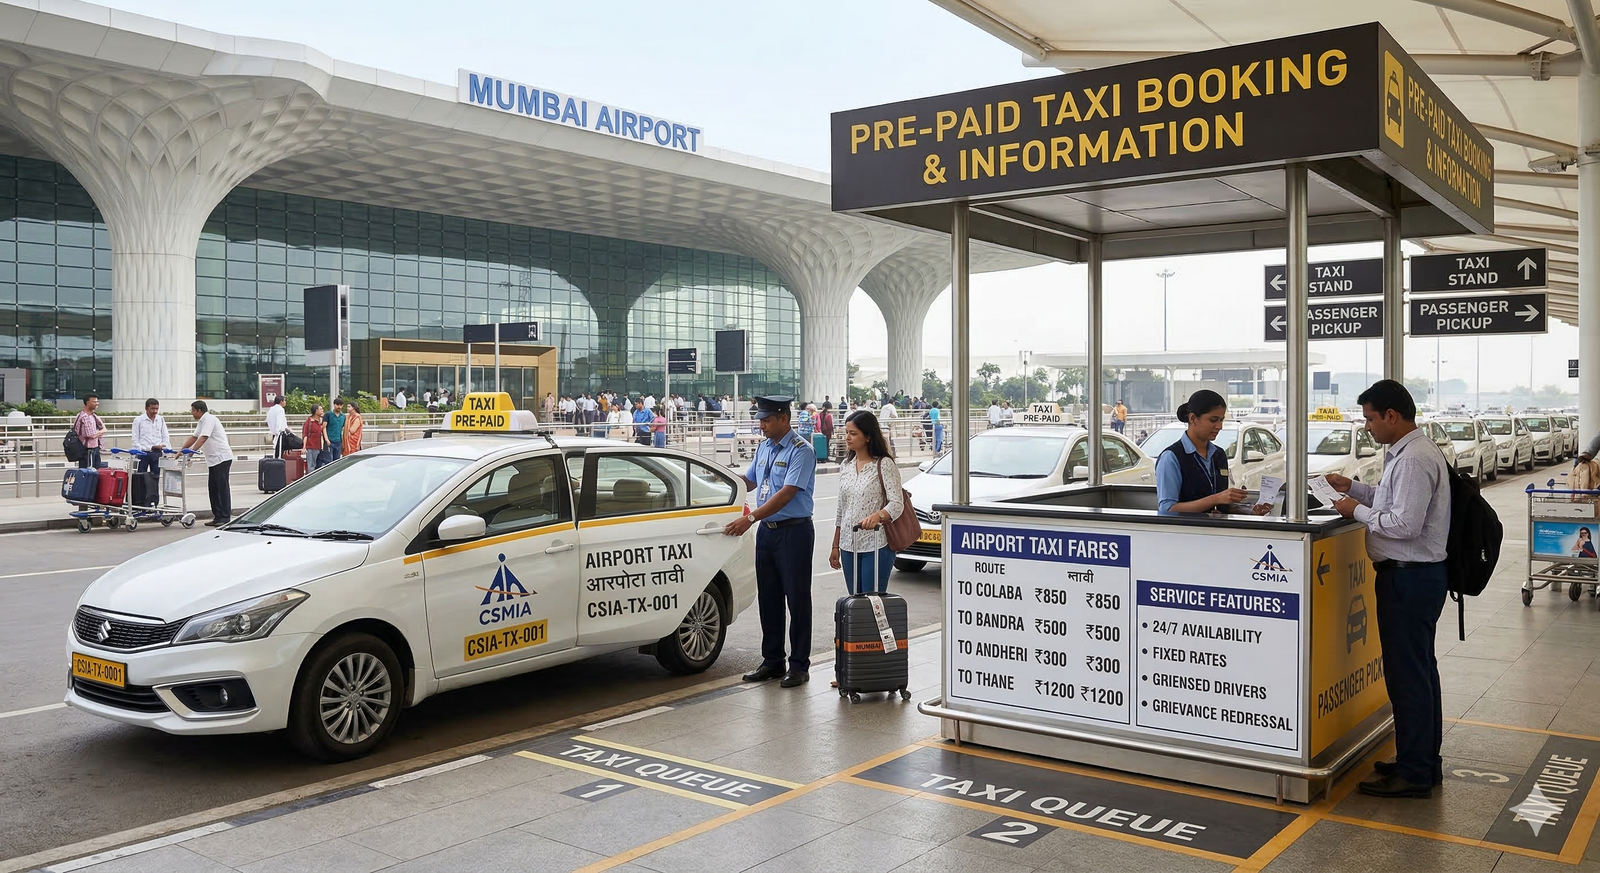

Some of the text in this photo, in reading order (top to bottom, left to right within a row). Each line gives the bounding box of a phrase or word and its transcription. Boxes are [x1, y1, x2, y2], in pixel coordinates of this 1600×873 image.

[469, 73, 700, 152] MUMBAI AIRPORT
[851, 49, 1348, 154] PRE-PAID TAXI BOOKING
[1408, 75, 1492, 182] PRE-PAID TAXI BOOKING
[922, 111, 1244, 186] & INFORMATION
[1426, 137, 1481, 209] & INFORMATION
[1315, 265, 1345, 278] TAXI
[1455, 255, 1490, 271] TAXI
[1308, 279, 1353, 293] STAND
[1448, 271, 1499, 286] STAND
[1307, 306, 1378, 321] ASSENGER
[1419, 300, 1510, 316] PASSENGER
[1311, 322, 1362, 336] PICKUP
[1436, 317, 1493, 332] PICKUP
[469, 397, 495, 411] TAXI
[1033, 404, 1053, 414] TAXI
[455, 414, 505, 428] PRE-PAID
[1023, 414, 1061, 423] PRE-PAID
[585, 542, 694, 570] AIRPORT TAXI
[961, 531, 1119, 561] AIRPORT TAXI FARES
[650, 563, 685, 586] तावी
[974, 562, 1006, 575] ROUTE
[1251, 571, 1289, 584] CSMIA
[1348, 558, 1366, 590] TAXI
[587, 593, 679, 619] CSIA-TX-001
[958, 580, 1121, 611] TO COLABA ₹850 ₹850
[1150, 586, 1287, 614] SERVICE FEATURES:
[479, 601, 533, 626] CSMIA
[958, 610, 1121, 642] TO BANDRA ₹500 ₹500
[467, 623, 545, 657] CSIA-TX-001
[1153, 620, 1263, 644] 24/7 AVAILABILITY
[958, 639, 1121, 675] TO ANDHERI ₹300 ₹300
[1153, 646, 1228, 668] FIXED RATES
[76, 658, 123, 683] CSIA-TX-0001
[958, 668, 1124, 707] TO THANE ₹1200 ₹1200
[1153, 672, 1267, 700] GRIENSED DRIVERS
[1318, 654, 1384, 720] PASSENGER PICK
[1153, 698, 1294, 732] GRIEVANCE REDRESSAL
[559, 744, 762, 798] TAXI QUEUE
[1451, 768, 1510, 783] 3
[1533, 754, 1589, 794] QUEUE
[580, 783, 625, 798] 1
[920, 773, 1207, 842] TAXI QUEUE
[980, 821, 1039, 844] 2
